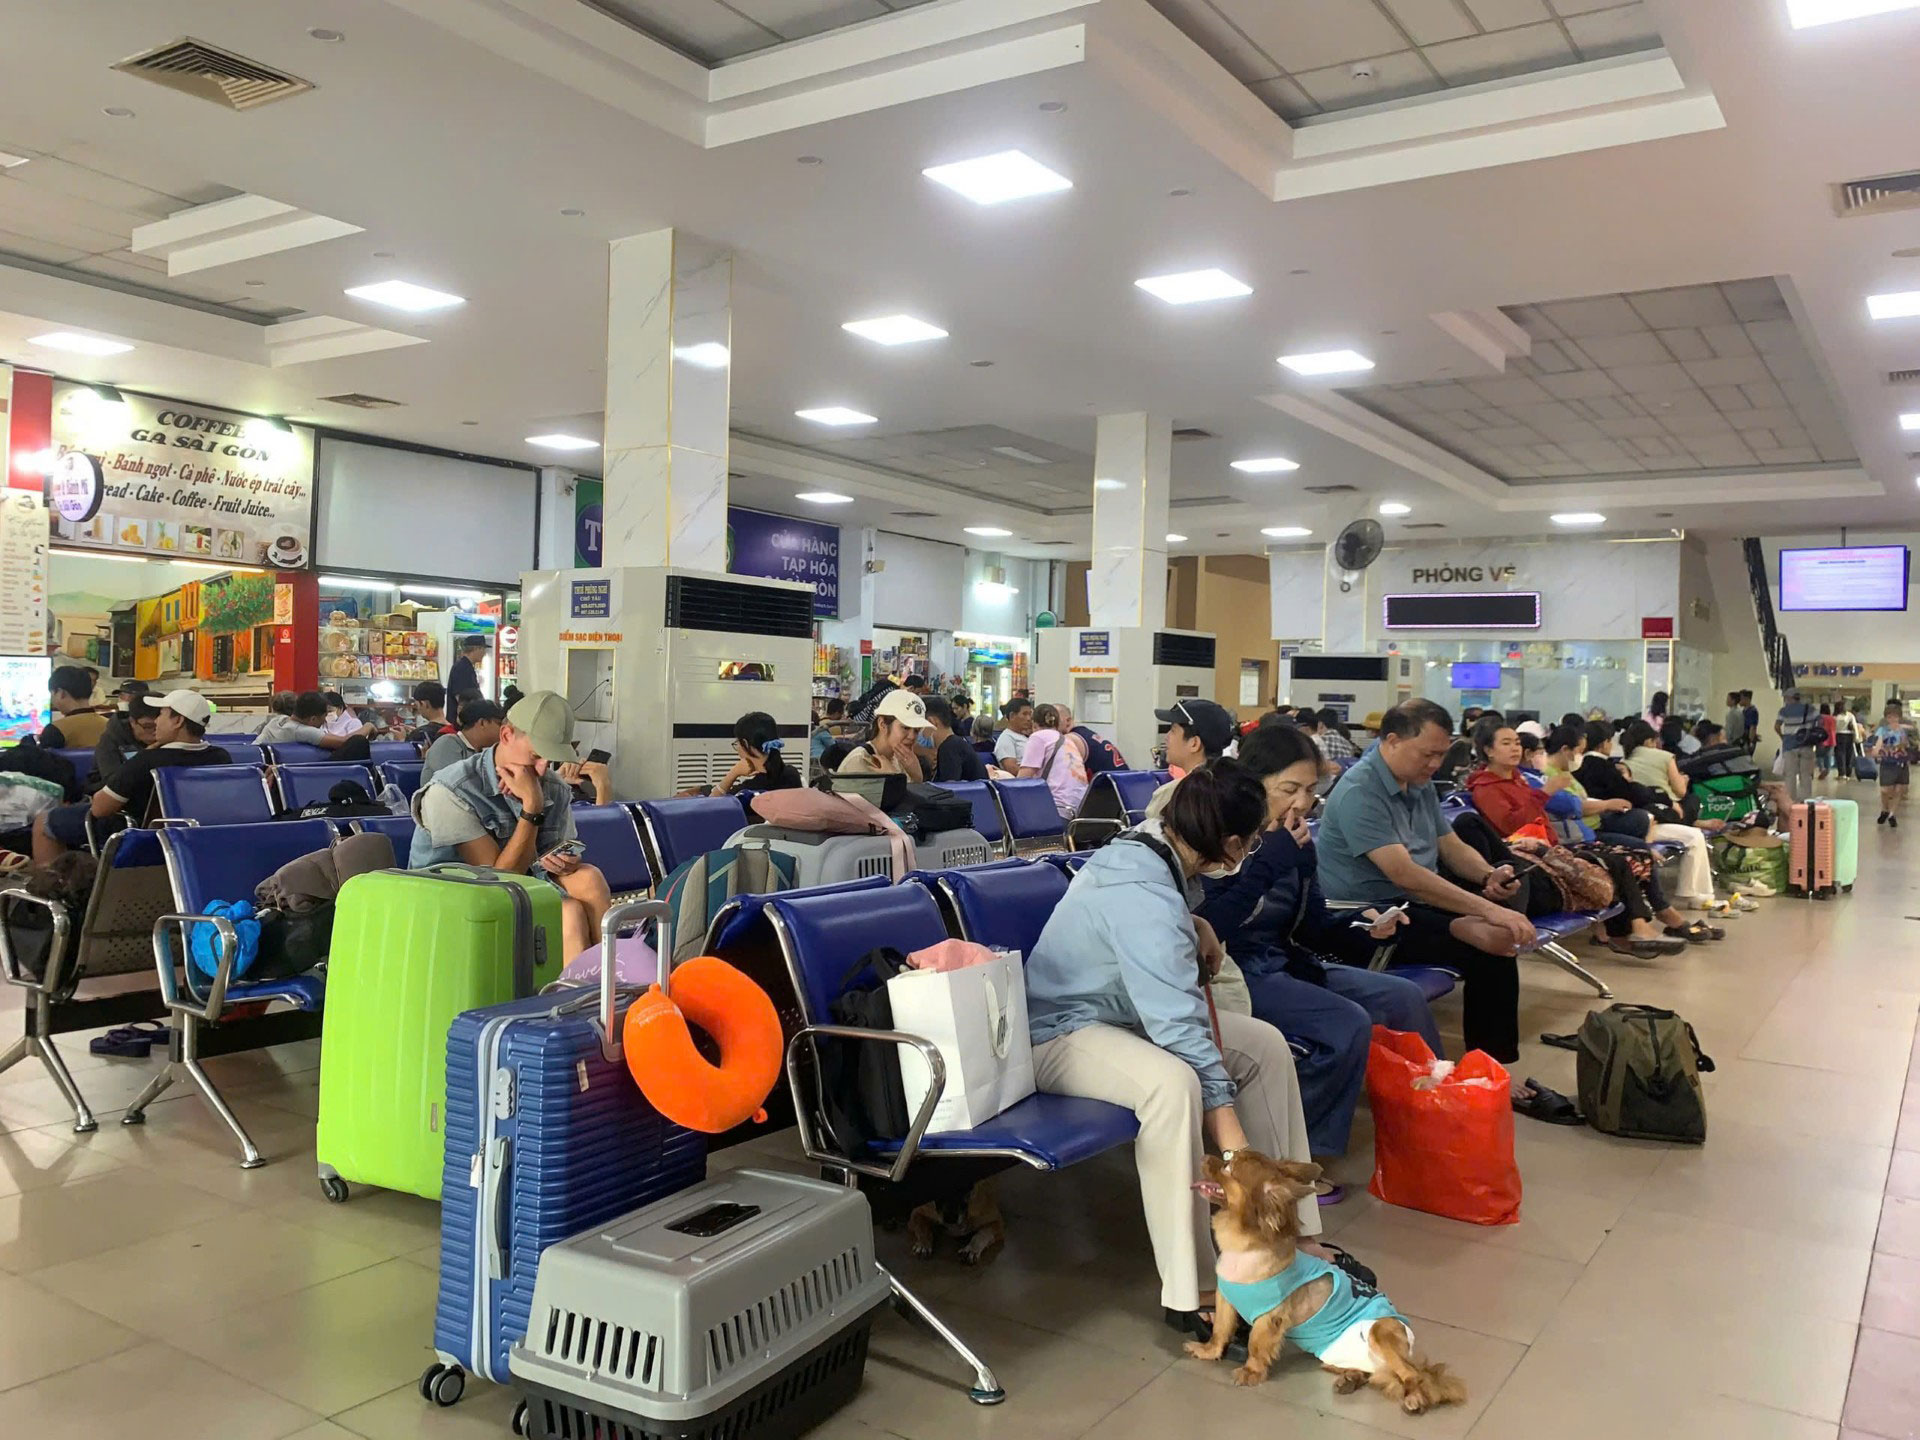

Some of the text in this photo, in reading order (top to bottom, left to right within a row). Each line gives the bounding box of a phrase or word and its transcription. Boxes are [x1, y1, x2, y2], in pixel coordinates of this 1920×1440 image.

[157, 410, 246, 438] COFFEE
[131, 429, 270, 461] GA SÀI GÒN
[112, 453, 144, 473] Bánh
[144, 463, 173, 481] ngọt
[180, 463, 195, 480] Cà
[192, 467, 217, 486] phê
[221, 470, 248, 489] Nước
[249, 474, 262, 494] ép
[263, 477, 285, 494] trái
[103, 482, 131, 498] read
[136, 484, 165, 503] Cake
[172, 489, 207, 509] Coffee
[213, 495, 243, 514] Fruit
[802, 535, 837, 557] HÀNG
[782, 556, 837, 577] TẠP HÓA
